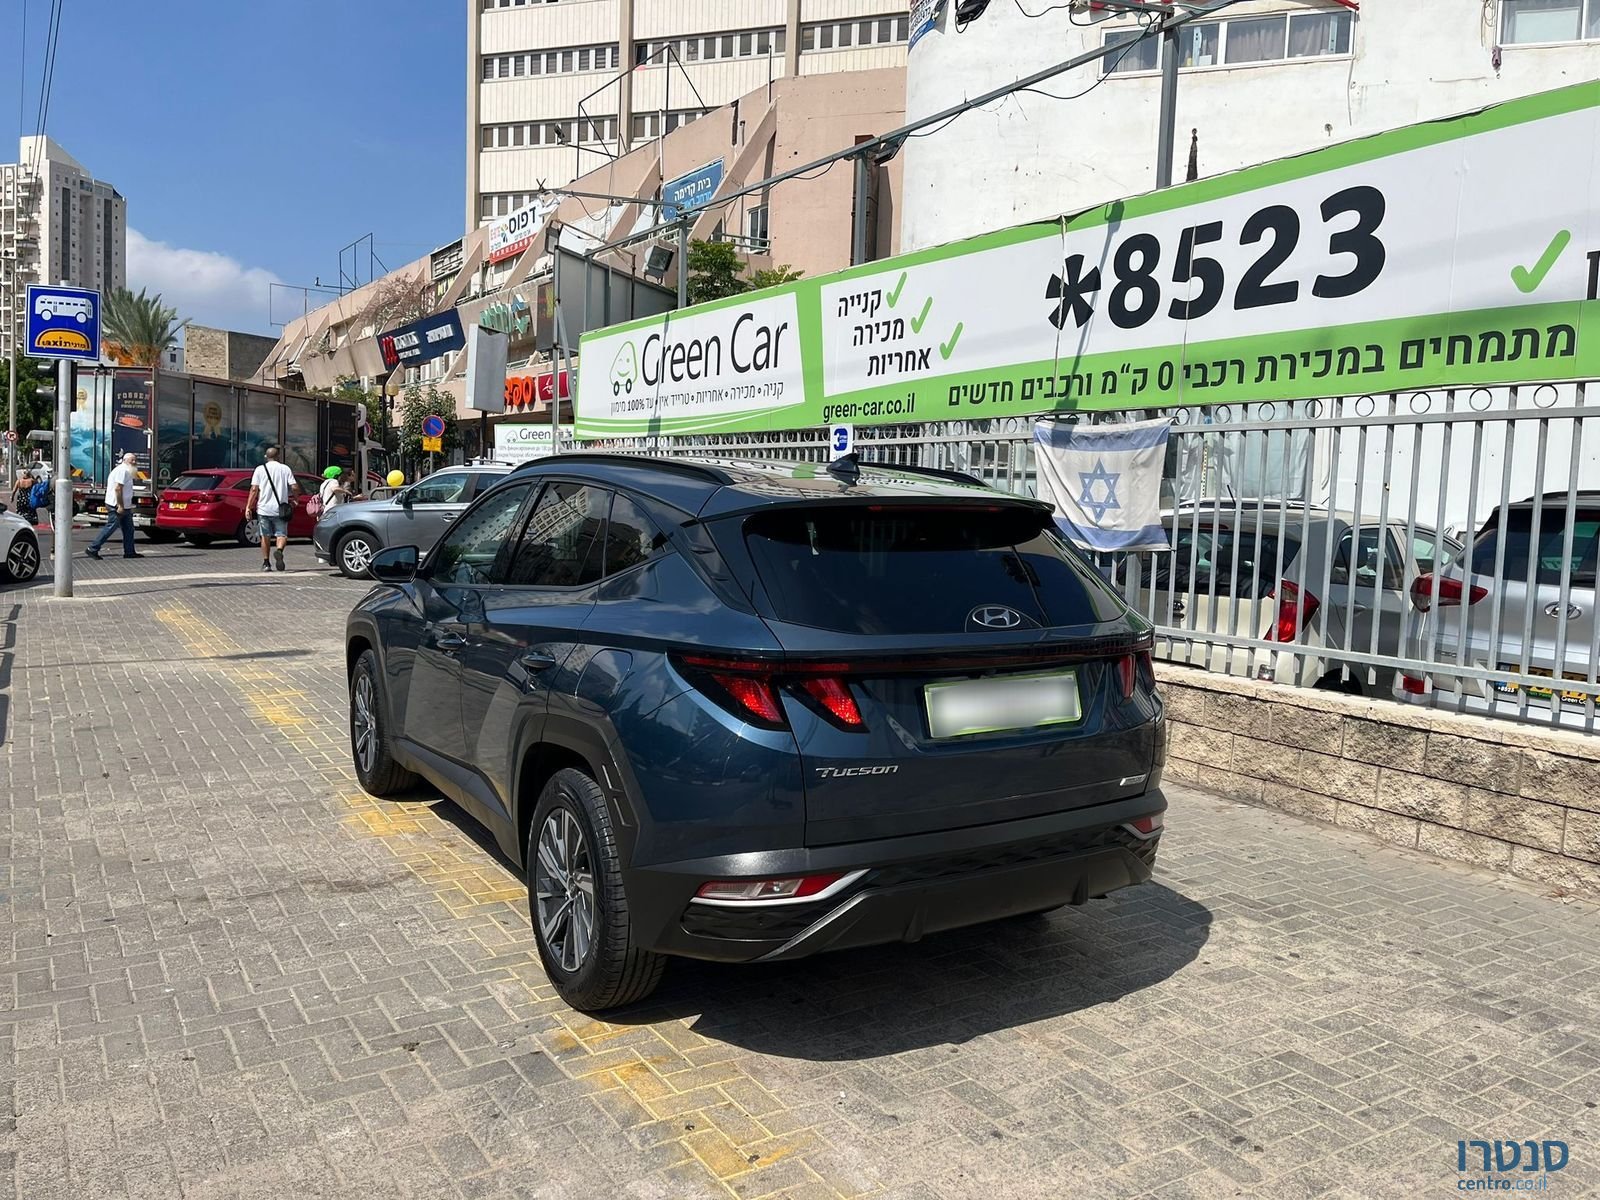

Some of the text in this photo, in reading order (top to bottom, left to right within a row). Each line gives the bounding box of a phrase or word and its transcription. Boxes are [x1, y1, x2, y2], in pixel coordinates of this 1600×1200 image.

[508, 206, 537, 234] דפוס
[838, 289, 882, 318] קנייה
[853, 318, 905, 347] מכירה
[642, 312, 788, 387] Green Car
[1399, 324, 1576, 370] מתמחים
[867, 347, 932, 377] אחריות
[1183, 360, 1245, 389] רכבי
[1254, 344, 1385, 383] במכירת
[695, 388, 724, 405] אחריות
[730, 387, 756, 400] מכירה
[763, 381, 784, 400] קניה
[948, 380, 1014, 406] חדשים
[1021, 374, 1093, 401] ורכבים
[627, 398, 645, 412] 100%
[823, 392, 915, 424] green-car.co.il
[519, 428, 551, 440] Green
